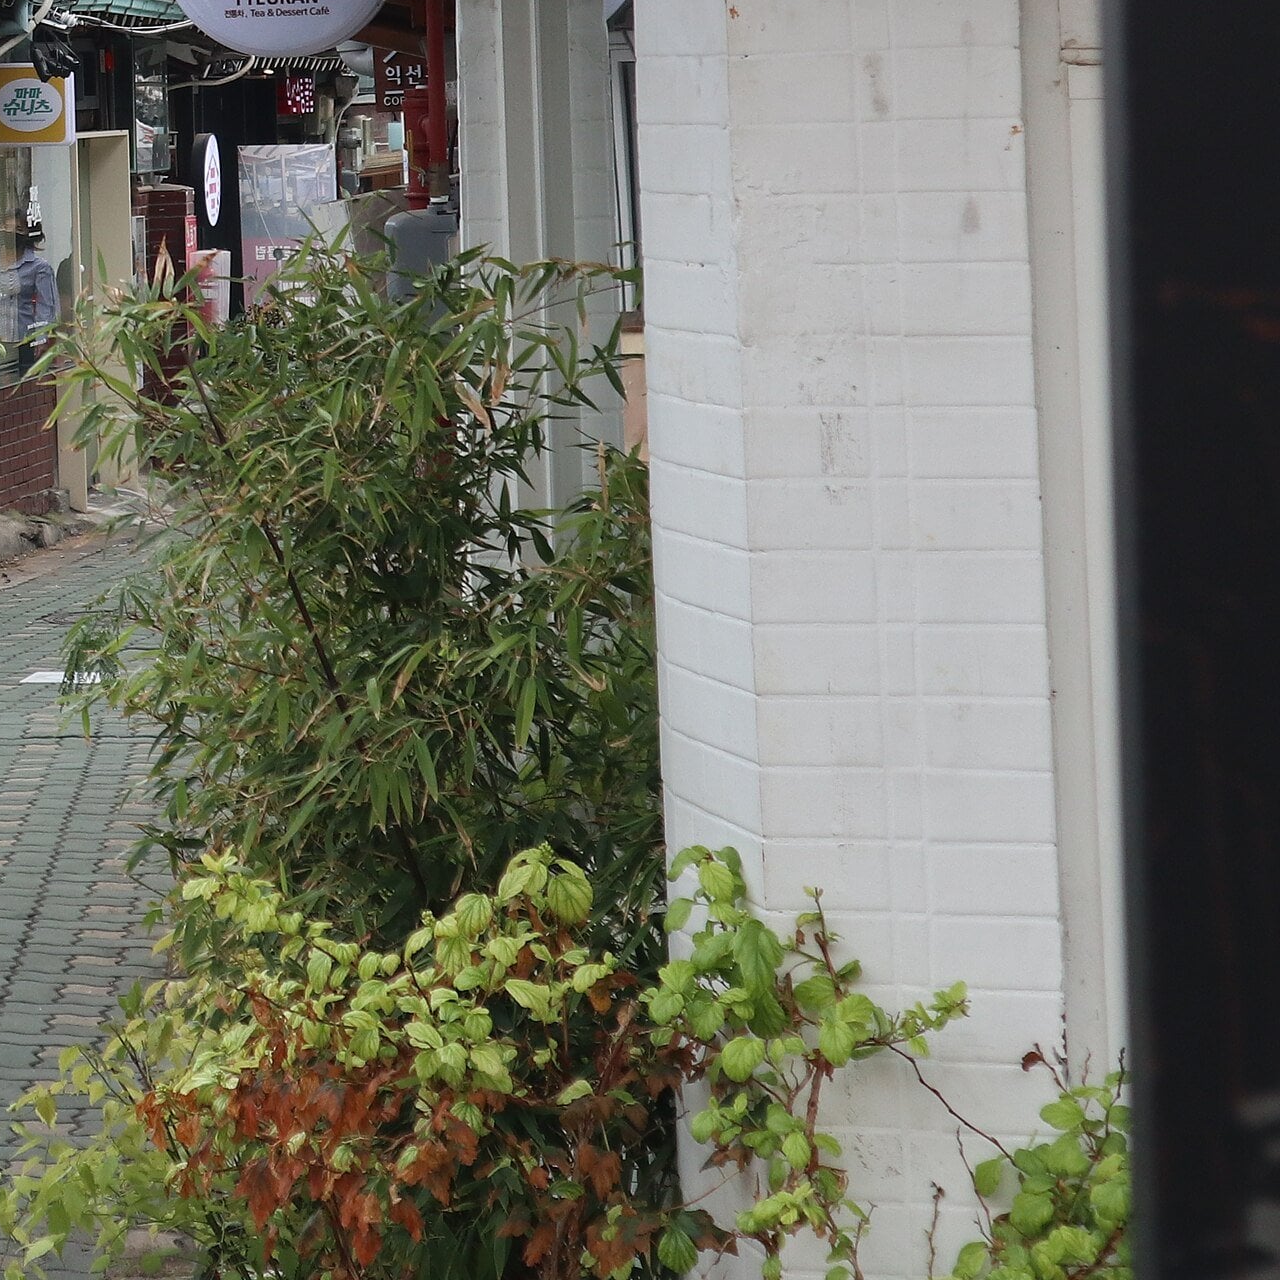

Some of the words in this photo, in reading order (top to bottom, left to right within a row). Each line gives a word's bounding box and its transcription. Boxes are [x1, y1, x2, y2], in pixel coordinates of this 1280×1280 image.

[250, 9, 266, 18] Tea
[266, 8, 275, 17] &
[275, 7, 309, 17] Dessert
[309, 6, 330, 16] Café
[3, 98, 53, 116] 슈니츠
